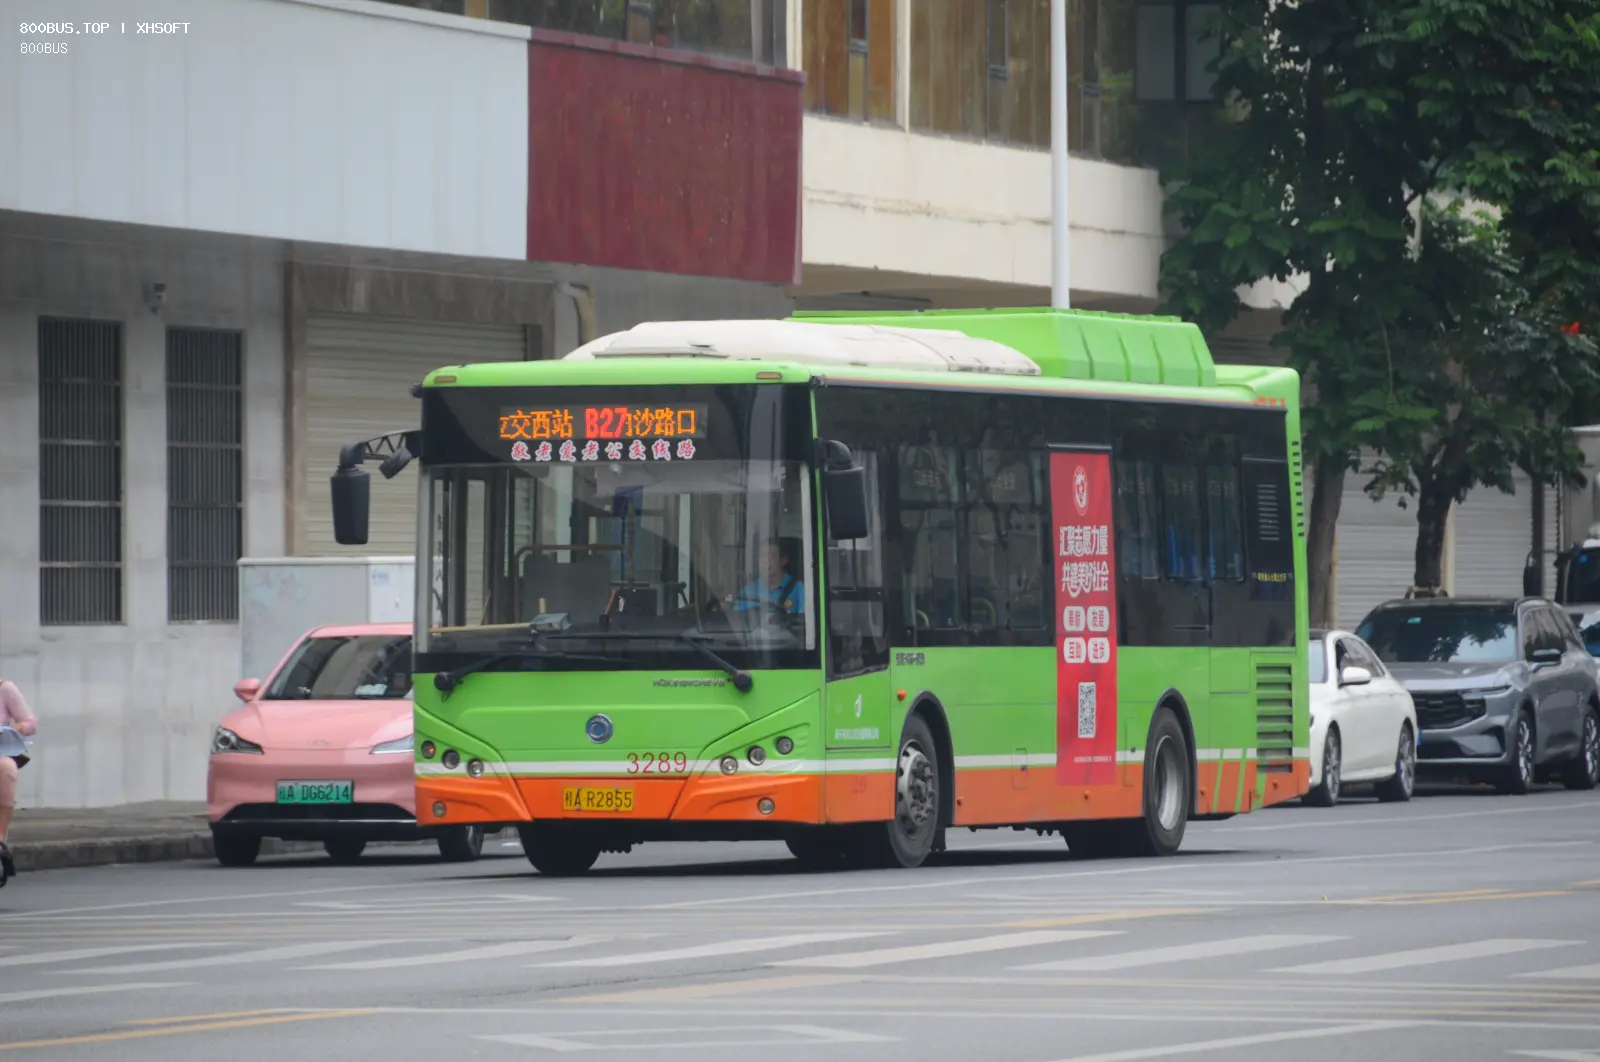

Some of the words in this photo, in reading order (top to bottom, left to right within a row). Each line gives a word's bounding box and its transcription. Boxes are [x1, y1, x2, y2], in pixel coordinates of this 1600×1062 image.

[585, 407, 628, 438] B27
[626, 752, 687, 774] 3289
[301, 784, 350, 801] DG6214
[586, 790, 633, 808] R2855
